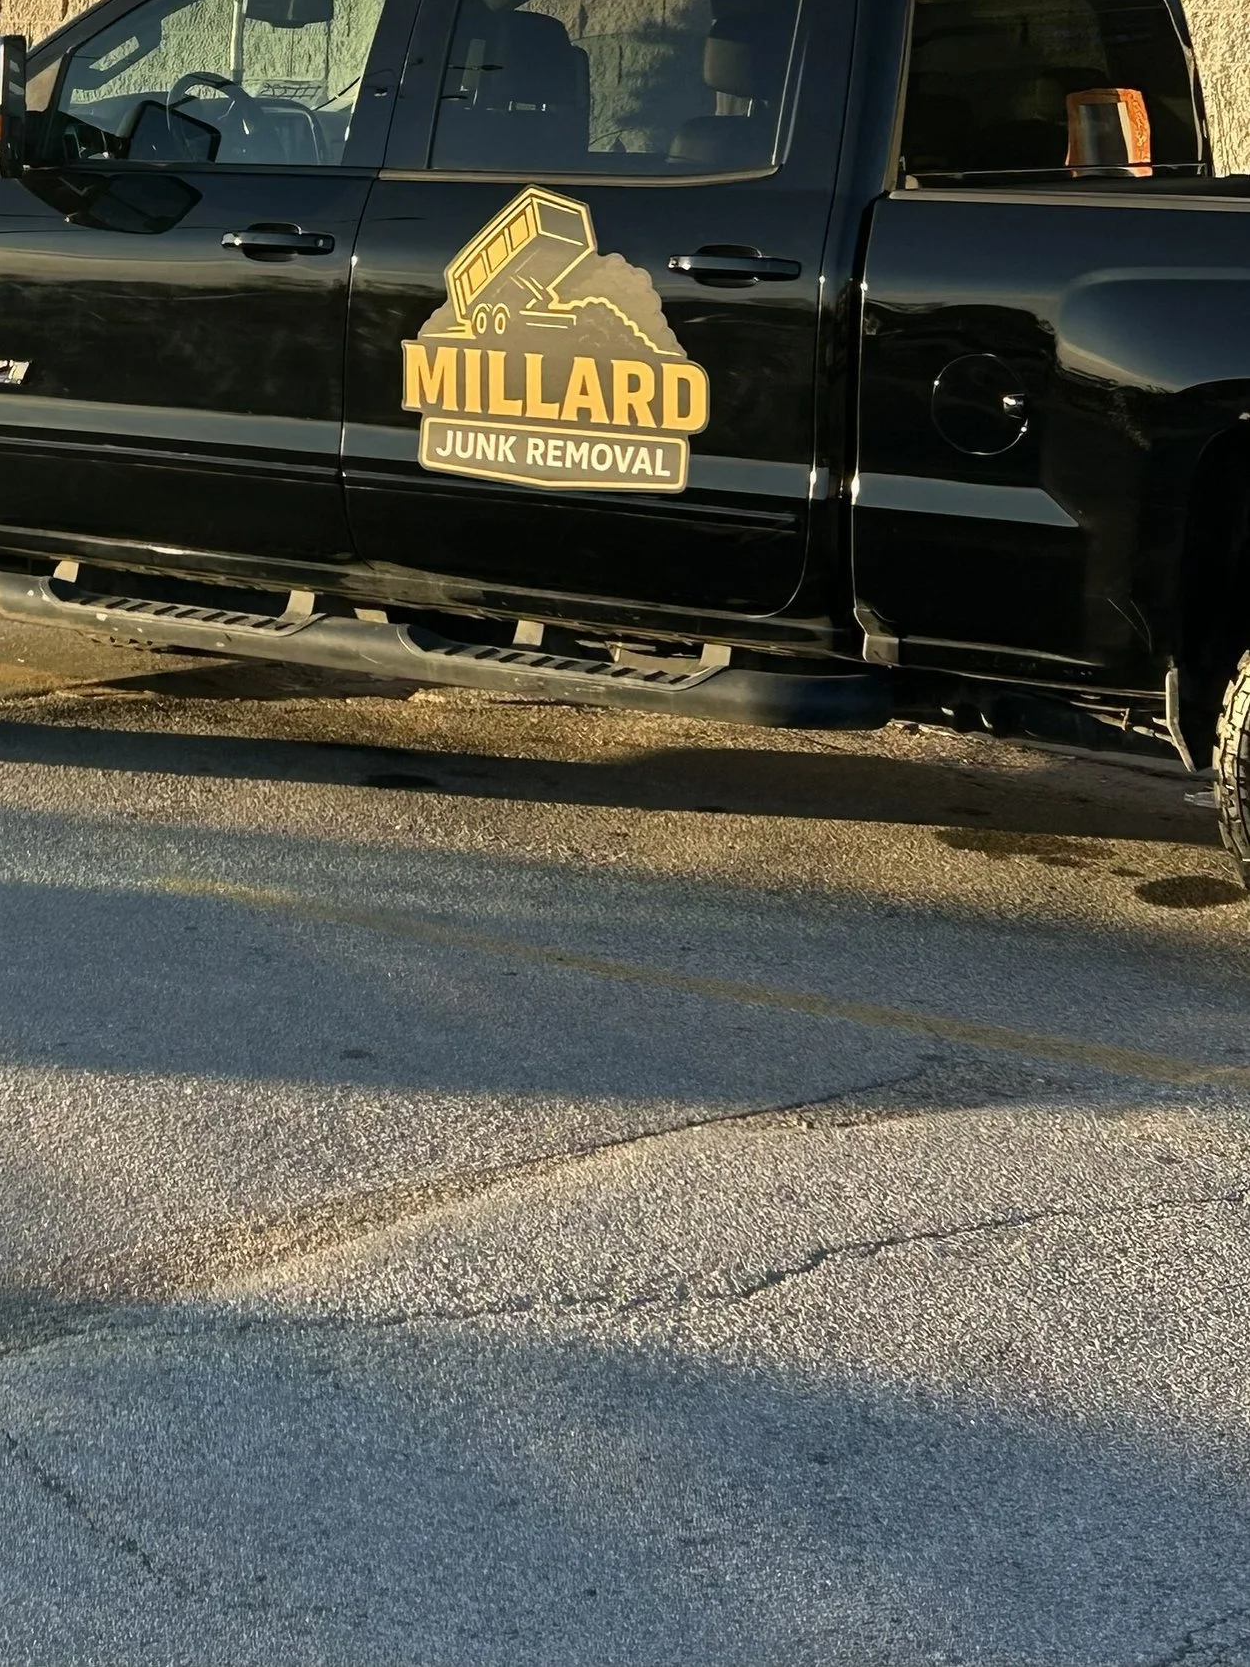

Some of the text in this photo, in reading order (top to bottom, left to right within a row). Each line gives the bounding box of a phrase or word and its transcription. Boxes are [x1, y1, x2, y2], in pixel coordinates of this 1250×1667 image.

[404, 343, 708, 432] MILLARD
[436, 430, 671, 478] JUNK REMOVAL
